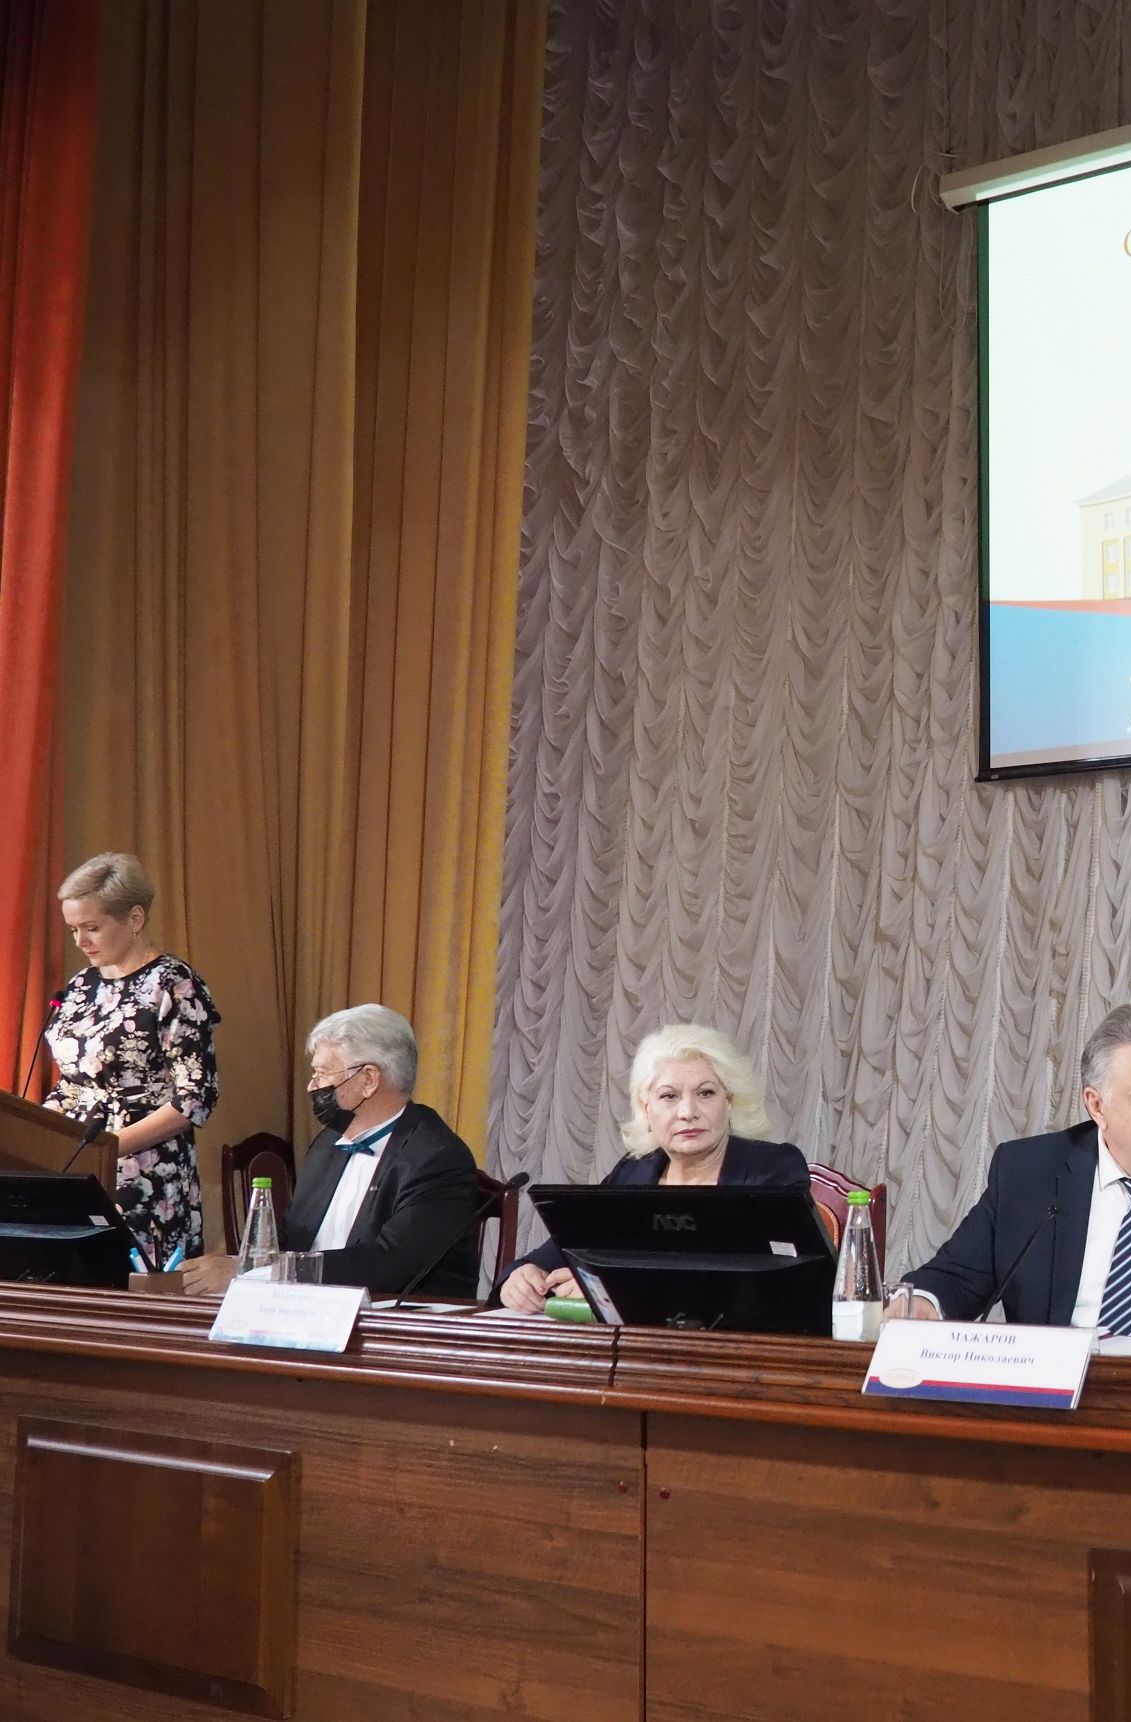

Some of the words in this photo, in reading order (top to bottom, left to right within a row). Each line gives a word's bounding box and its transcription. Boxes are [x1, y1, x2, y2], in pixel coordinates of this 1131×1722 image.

[950, 1332, 1017, 1345] МАЖАРОВ
[920, 1348, 961, 1363] Виктор
[964, 1351, 1035, 1365] Николаевич
